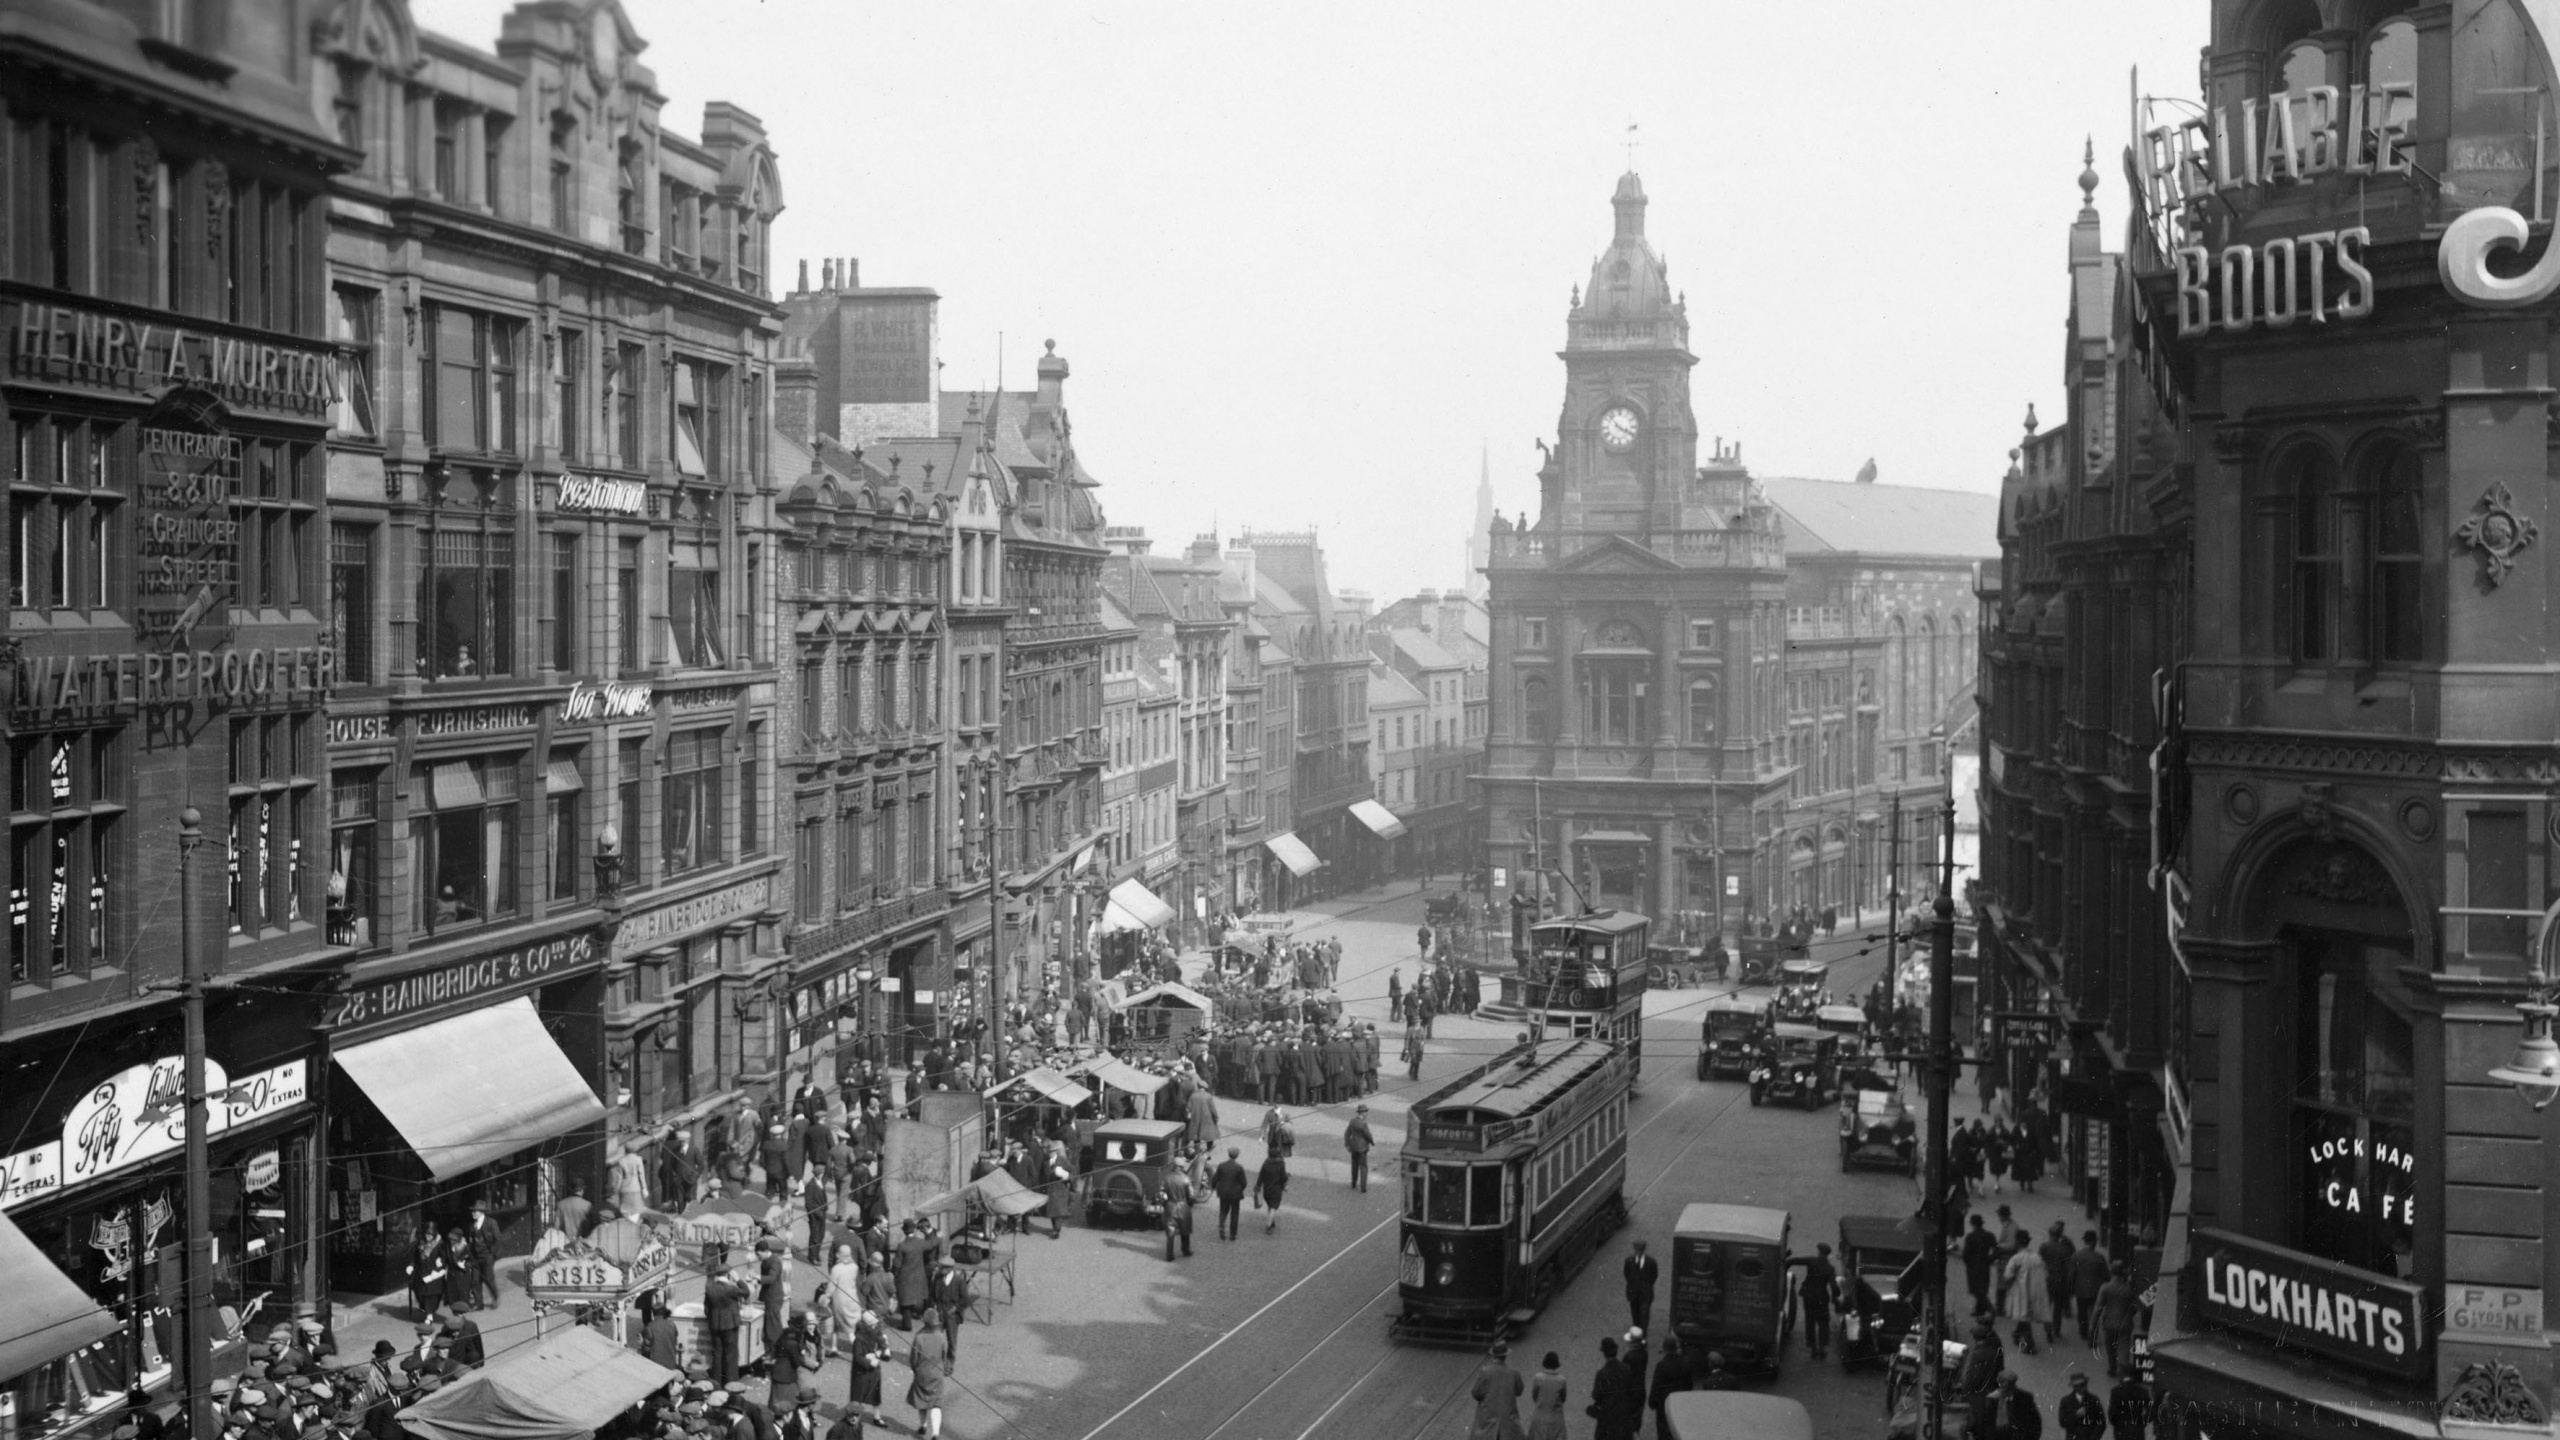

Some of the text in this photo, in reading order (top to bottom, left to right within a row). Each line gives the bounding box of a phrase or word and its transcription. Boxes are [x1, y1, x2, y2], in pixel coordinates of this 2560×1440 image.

[2142, 82, 2415, 219] RELIABLE
[2177, 226, 2374, 341] BOOTS
[871, 320, 916, 337] WHITE
[20, 302, 152, 375] HENRY
[212, 336, 342, 402] MURTON
[151, 430, 238, 462] ENTRANCE
[167, 471, 225, 506] 8 & 10
[153, 513, 237, 544] GRAINGER
[160, 557, 229, 586] STREET
[25, 648, 336, 710] WATERPROOFER
[672, 687, 733, 709] HOLESALE
[326, 705, 529, 744] HOUSE FURNISHING
[648, 896, 717, 941] BAINBRIDGE
[383, 957, 505, 1015] BAINBRIDGE
[510, 953, 521, 979] &
[527, 945, 550, 974] CO
[570, 933, 592, 964] 26
[283, 1069, 294, 1079] NO
[272, 1087, 303, 1105] EXTRAS
[29, 1152, 42, 1165] NO
[14, 1174, 56, 1198] EXTRAS
[2206, 1257, 2404, 1356] LOCKHARTS
[2135, 1337, 2150, 1355] BA
